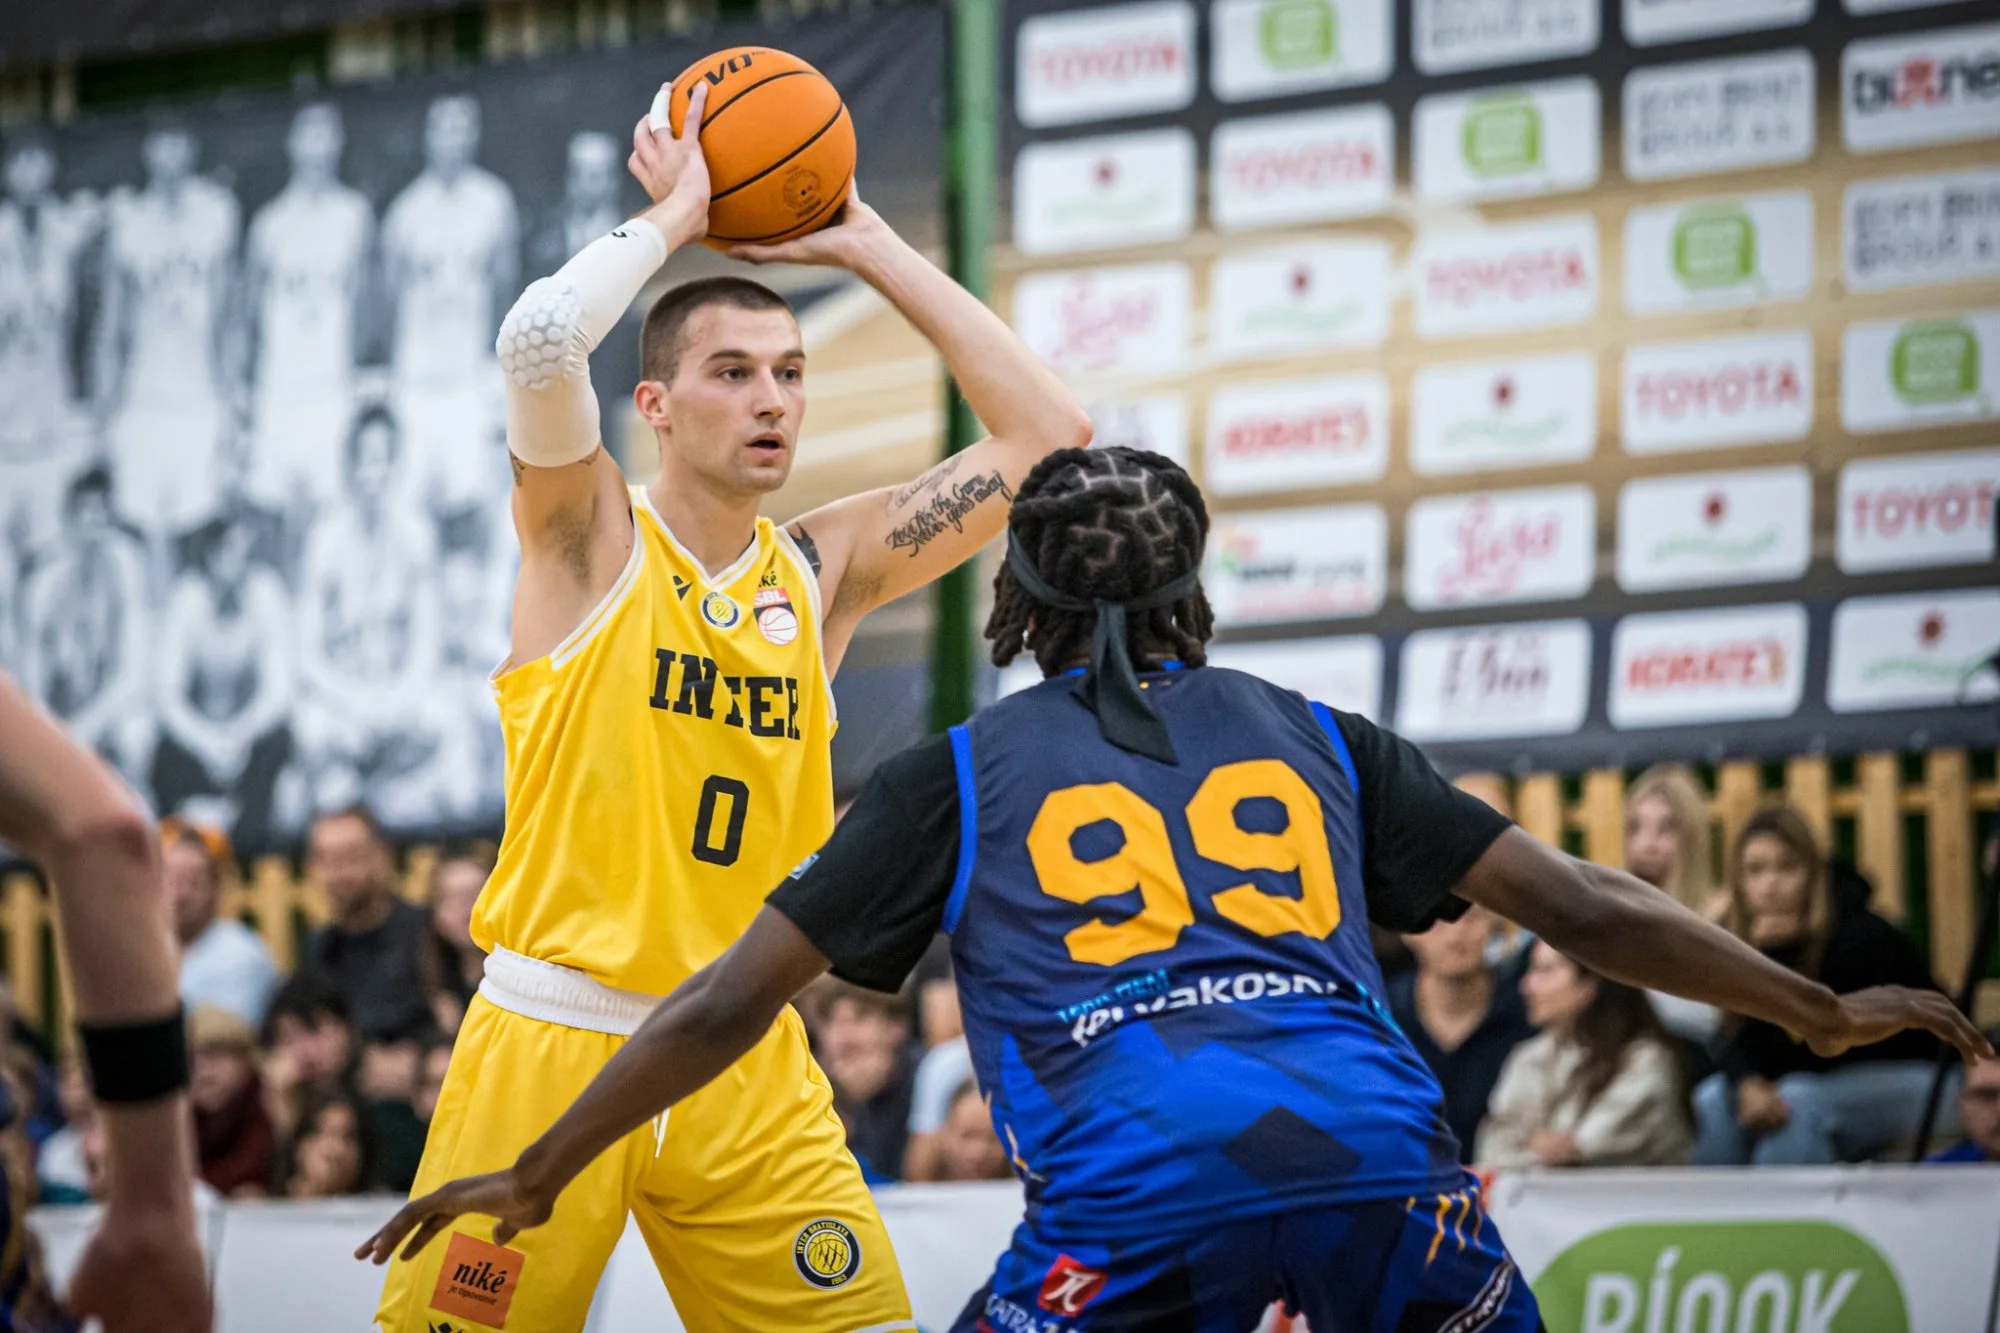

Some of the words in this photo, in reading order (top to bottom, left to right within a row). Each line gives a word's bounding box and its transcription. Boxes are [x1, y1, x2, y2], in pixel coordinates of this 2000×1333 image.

[1635, 357, 1803, 419] TOYOTA
[1852, 482, 1998, 542] TOYOT
[755, 588, 788, 606] SBL
[649, 648, 801, 741] INTER
[691, 774, 750, 868] 0
[1026, 758, 1341, 967] 99
[453, 1261, 507, 1294] niké
